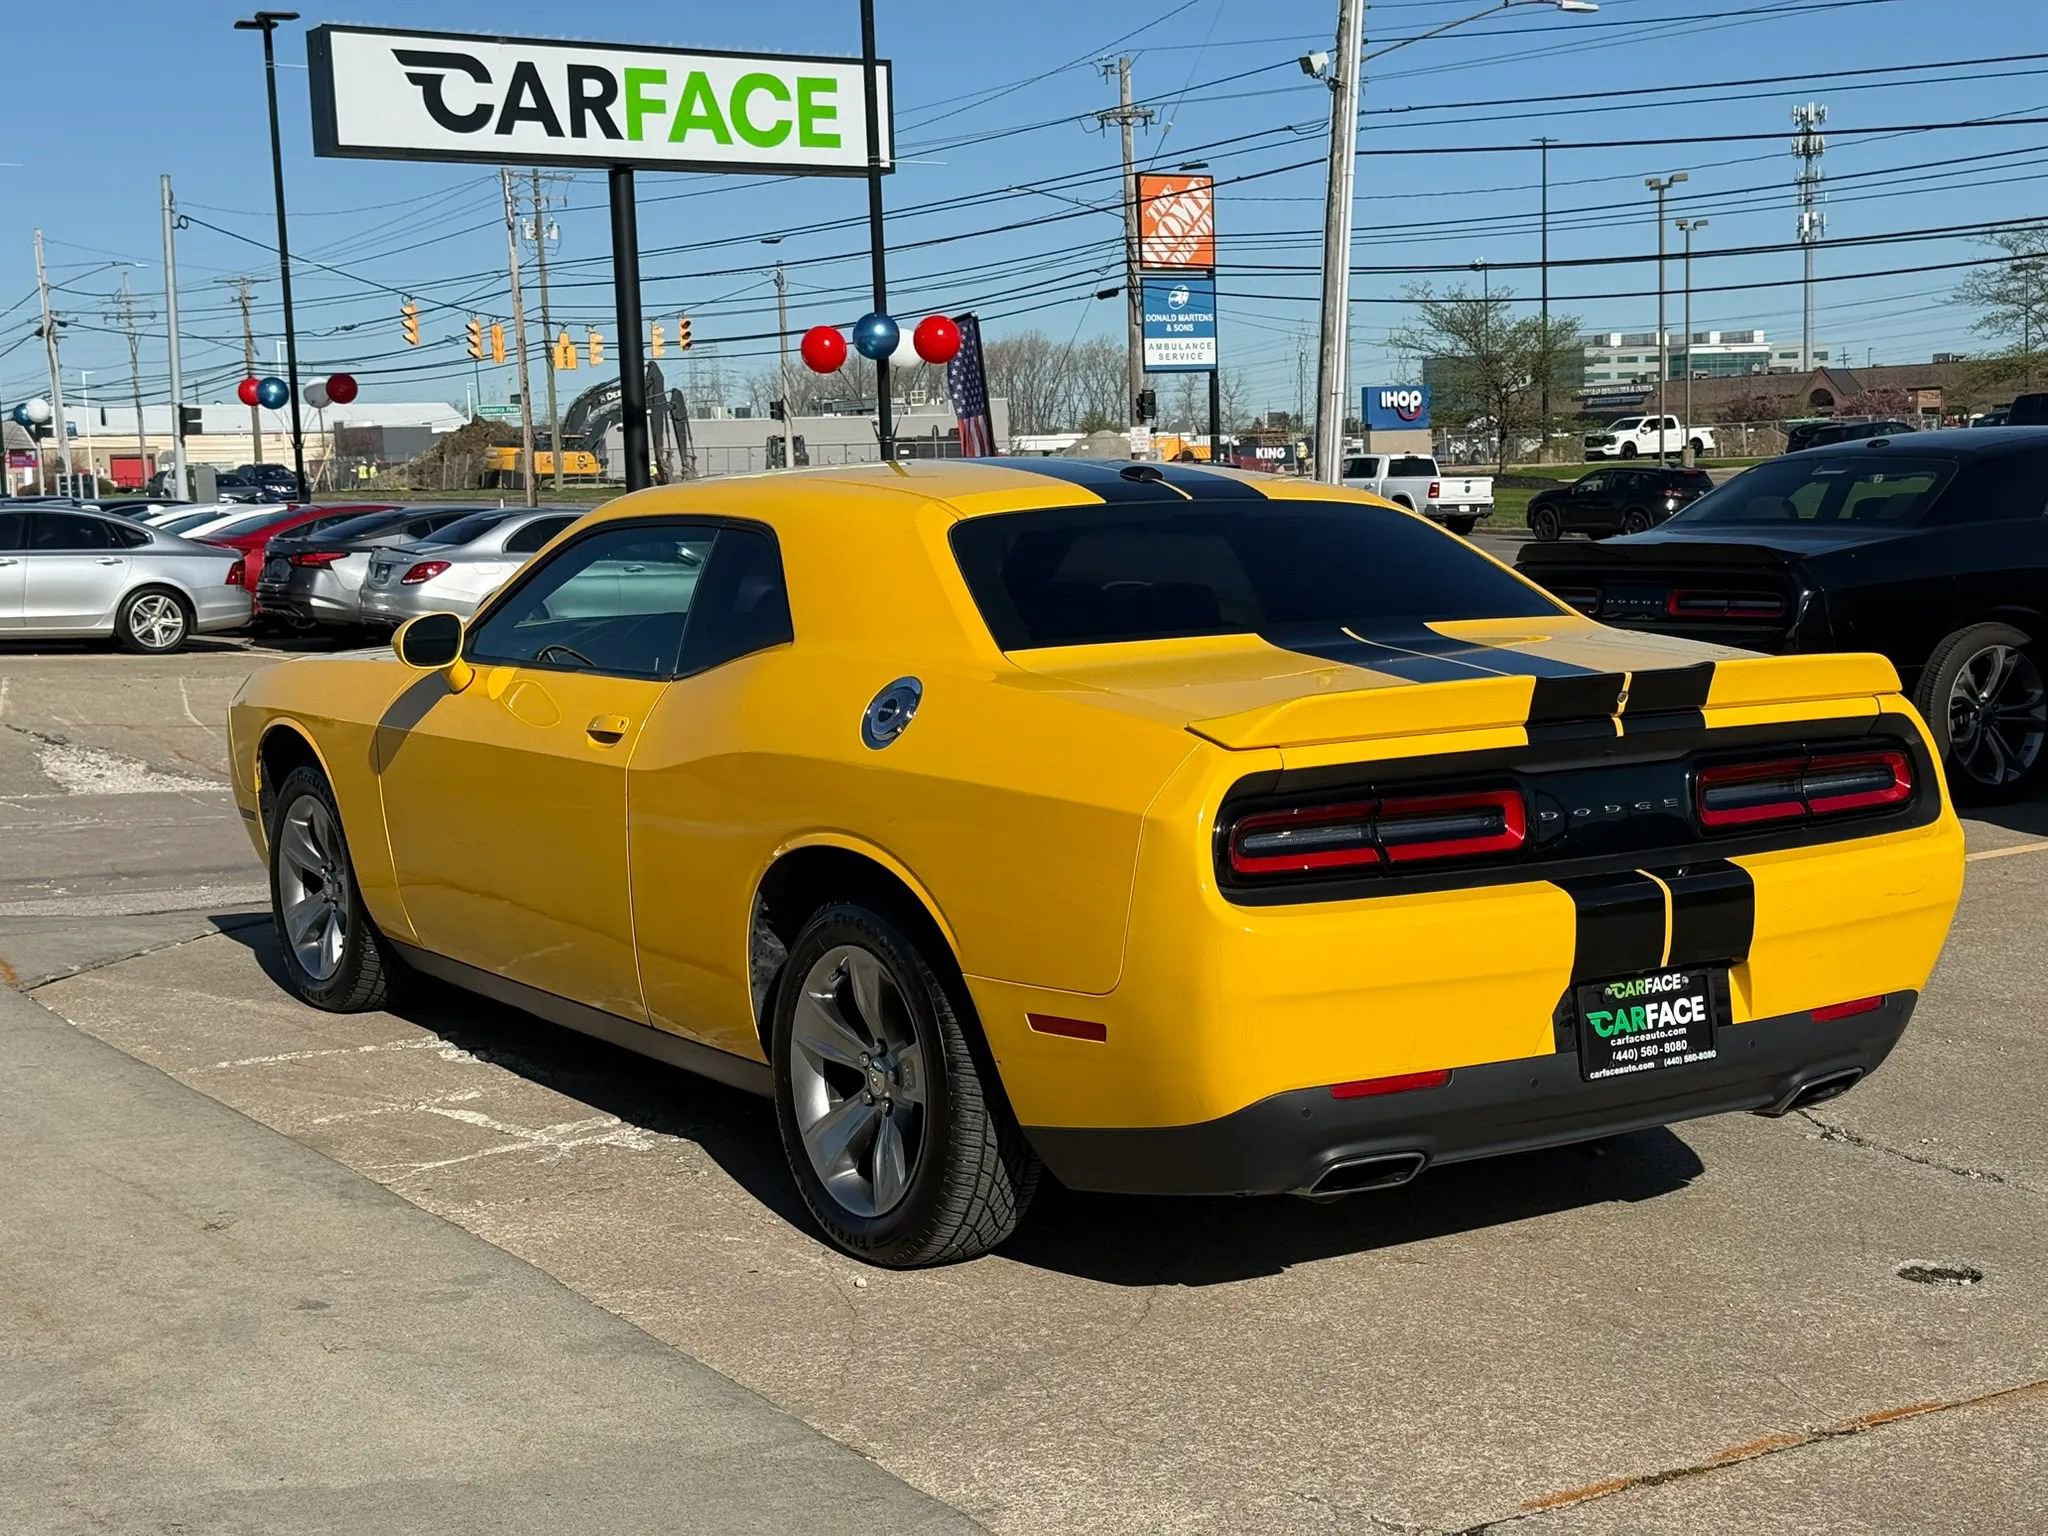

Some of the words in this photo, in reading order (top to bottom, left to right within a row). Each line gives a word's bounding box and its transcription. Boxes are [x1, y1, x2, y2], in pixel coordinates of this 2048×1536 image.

[391, 48, 841, 148] CARFACE
[1142, 177, 1211, 267] HOME
[1145, 313, 1177, 322] DONALD
[1178, 313, 1214, 322] MARTENS
[1166, 324, 1172, 332] &
[1173, 323, 1194, 332] SONS
[1148, 342, 1212, 351] AMBULANCE
[1158, 352, 1203, 361] SERVICE
[1381, 390, 1422, 412] IHOP
[1256, 447, 1286, 459] KING
[1540, 798, 1678, 821] DODGE
[1610, 973, 1682, 999] CARFACE
[1586, 995, 1706, 1038] CARFACE
[1610, 1027, 1687, 1046] carfaceauto.com
[1612, 1047, 1638, 1062] (440)
[1589, 1061, 1655, 1080] carfaceauto.com
[1663, 1055, 1682, 1068] (440)
